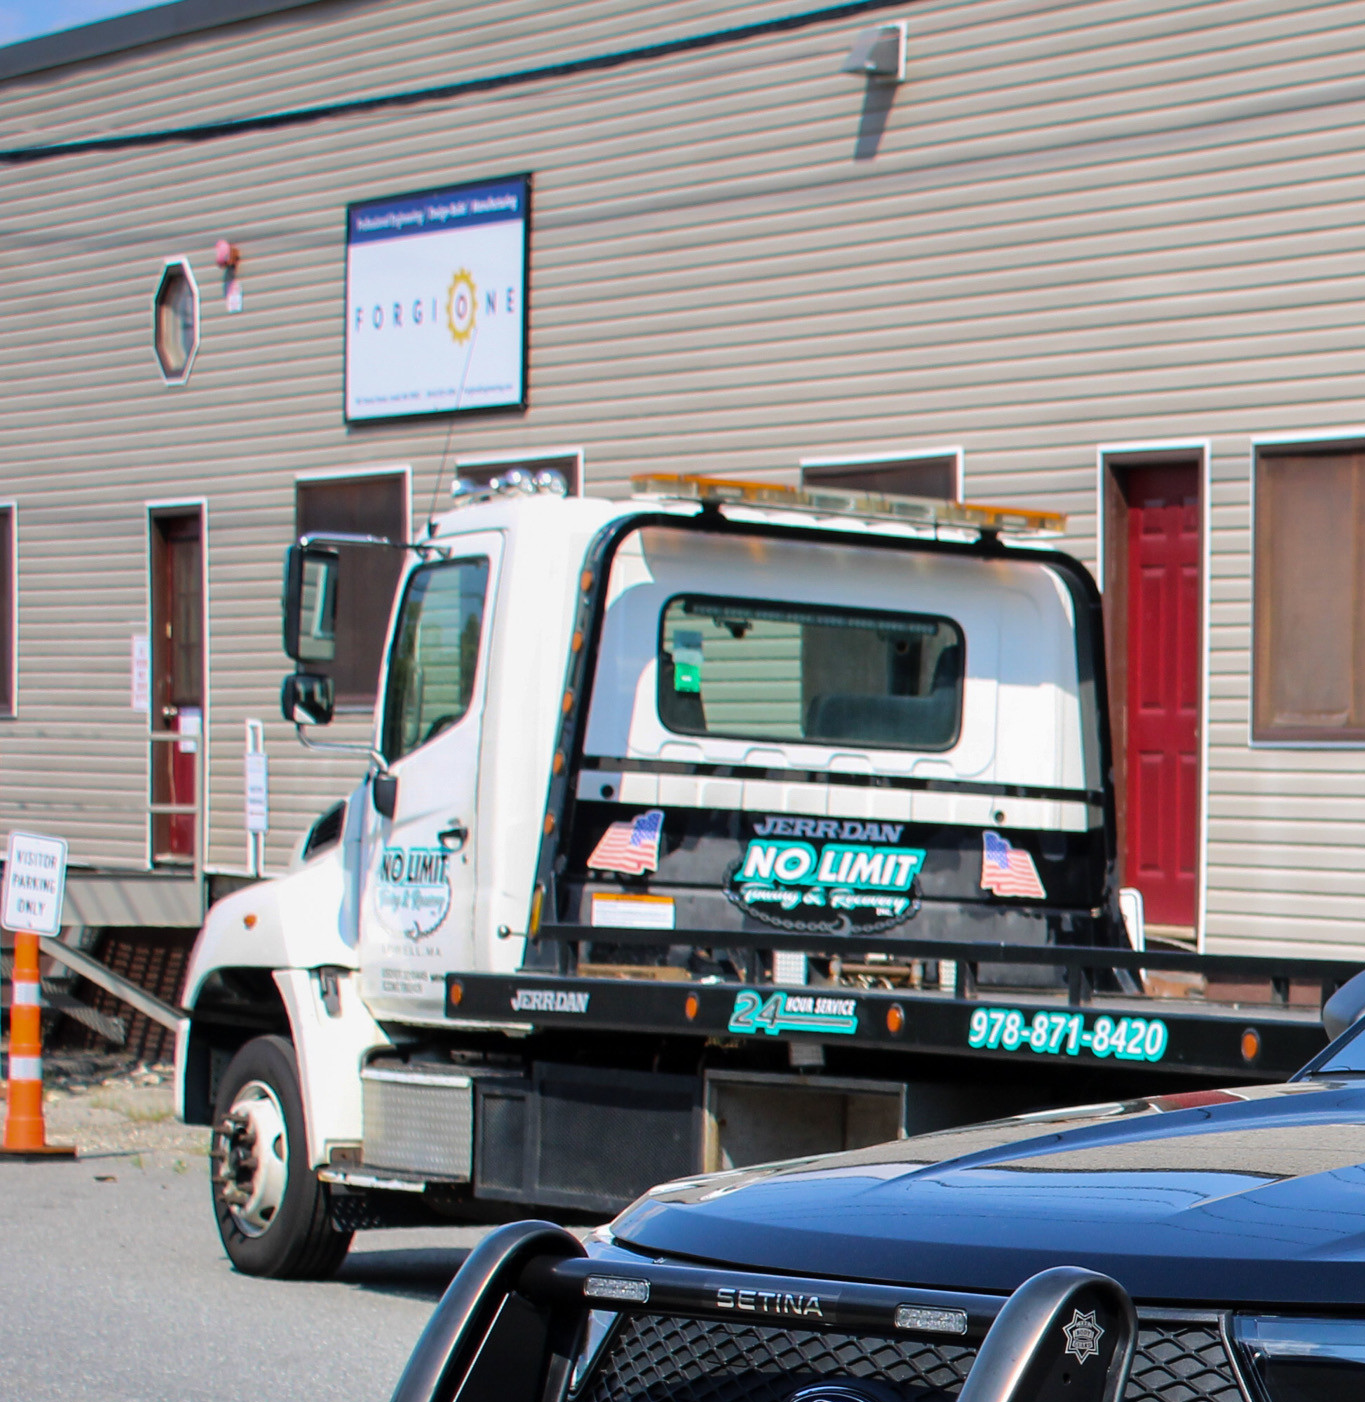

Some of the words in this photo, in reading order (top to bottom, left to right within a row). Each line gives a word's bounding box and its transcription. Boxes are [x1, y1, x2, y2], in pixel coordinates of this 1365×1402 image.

[16, 850, 58, 869] VISITOR
[379, 853, 406, 884] NO
[407, 853, 449, 884] LIMIT
[743, 845, 812, 881] NO
[816, 850, 919, 887] LIMIT
[12, 872, 57, 894] PARKING
[740, 881, 801, 910] Towing
[802, 886, 825, 907] &
[828, 888, 910, 915] Recovery
[16, 897, 46, 917] ONLY
[730, 990, 786, 1033] 24
[784, 996, 814, 1014] HOUR
[814, 997, 856, 1016] SERVICE
[968, 1010, 1164, 1056] 978-871-8420
[716, 1287, 824, 1317] SETINA
